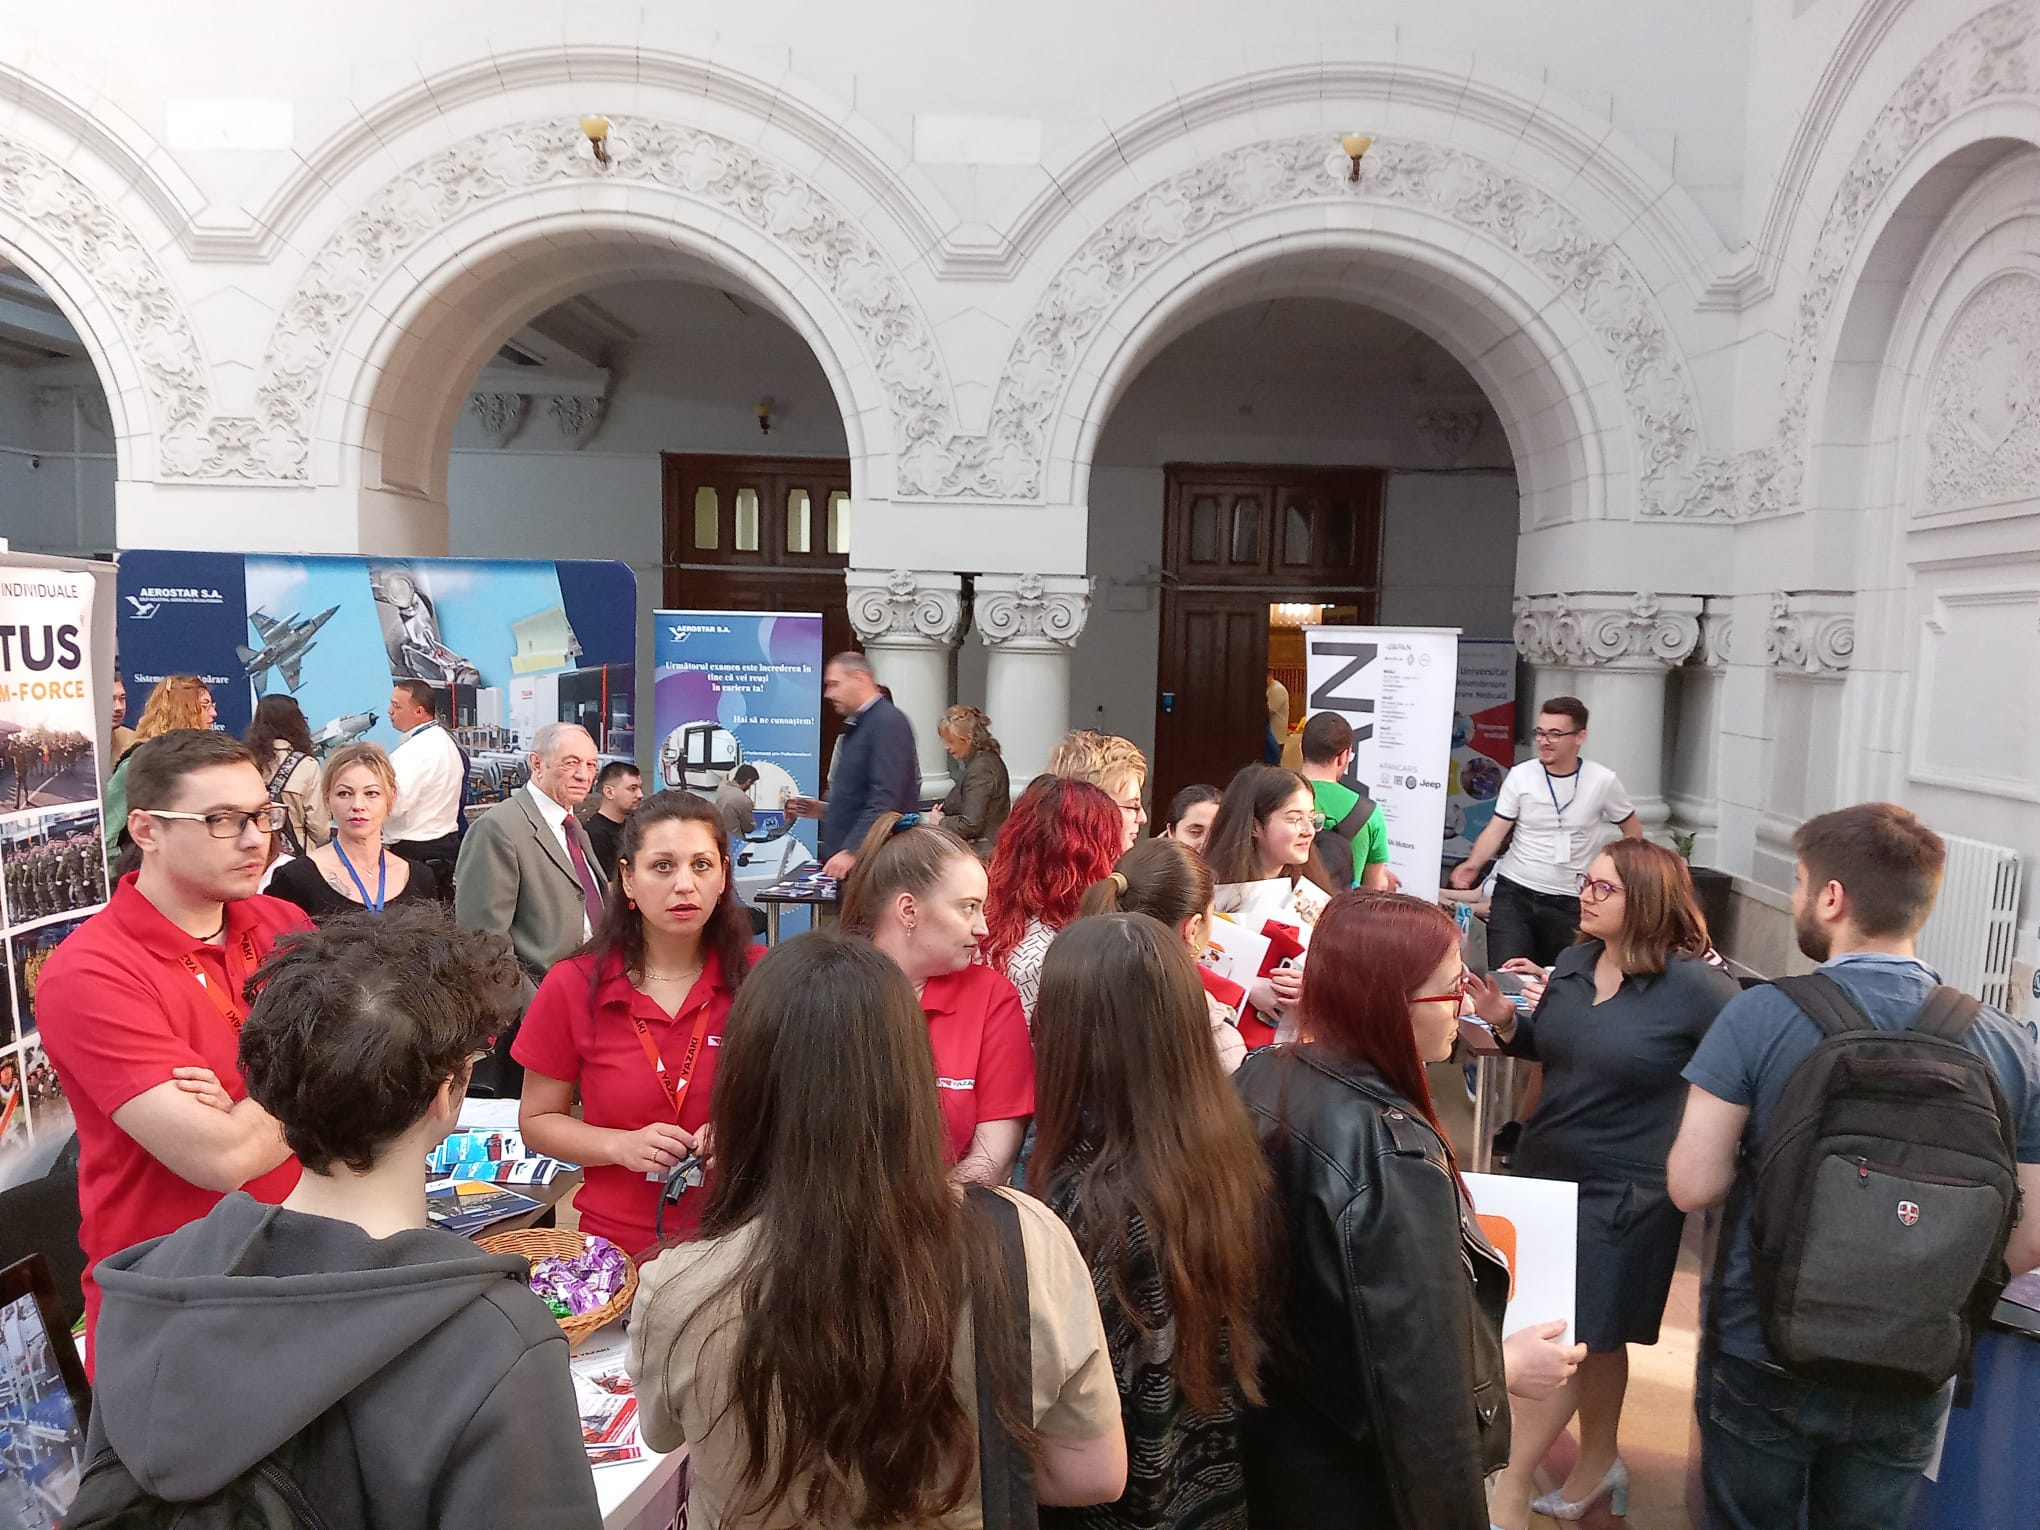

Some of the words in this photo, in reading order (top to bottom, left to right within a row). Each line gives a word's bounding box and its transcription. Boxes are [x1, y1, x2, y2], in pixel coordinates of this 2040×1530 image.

[1, 582, 79, 599] INDIVIDUALE
[140, 587, 199, 598] AEROSTAR
[200, 588, 223, 598] S.A.
[676, 624, 716, 633] AEROSTAR
[665, 660, 709, 671] Următorul
[709, 664, 741, 672] examen
[742, 664, 758, 672] este
[733, 715, 748, 724] Hai
[749, 715, 758, 724] să
[1419, 778, 1441, 789] Jeep
[681, 1036, 699, 1076] YAZAKI
